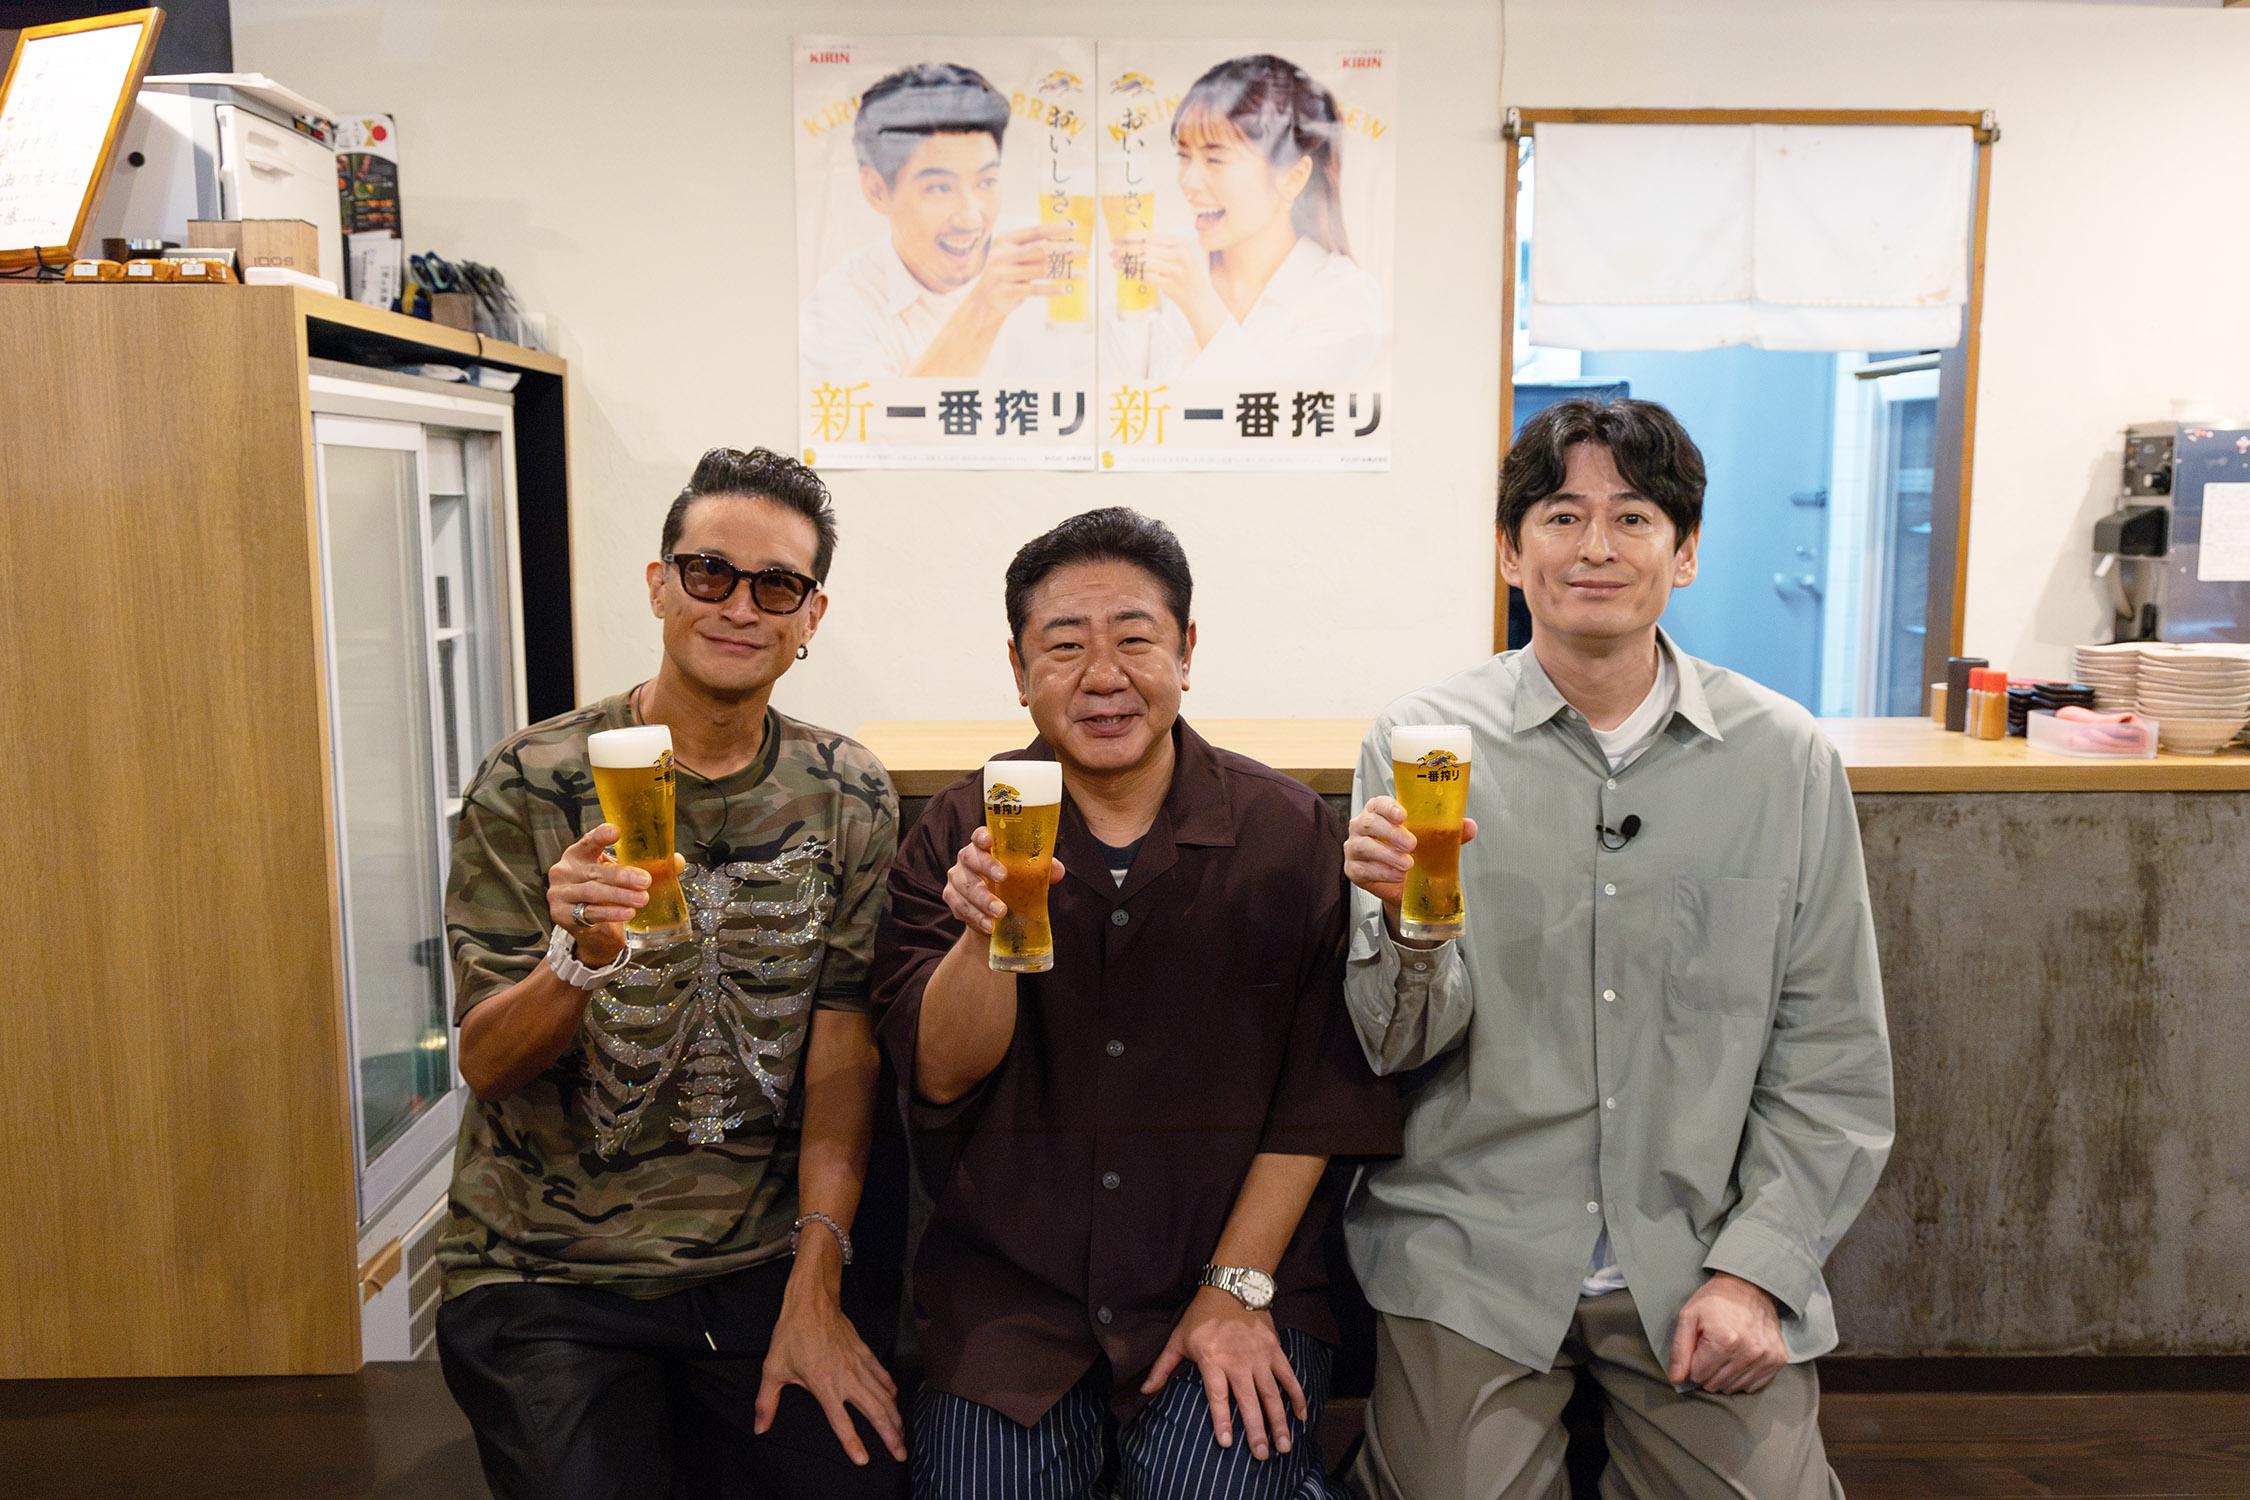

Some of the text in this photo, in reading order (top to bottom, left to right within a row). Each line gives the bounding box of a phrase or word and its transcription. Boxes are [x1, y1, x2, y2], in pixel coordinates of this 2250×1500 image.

[808, 52, 850, 64] KIRIN
[1342, 56, 1382, 69] KIRIN
[1416, 769, 1460, 782] 一番搾り
[987, 803, 1023, 816] 一番搾り
